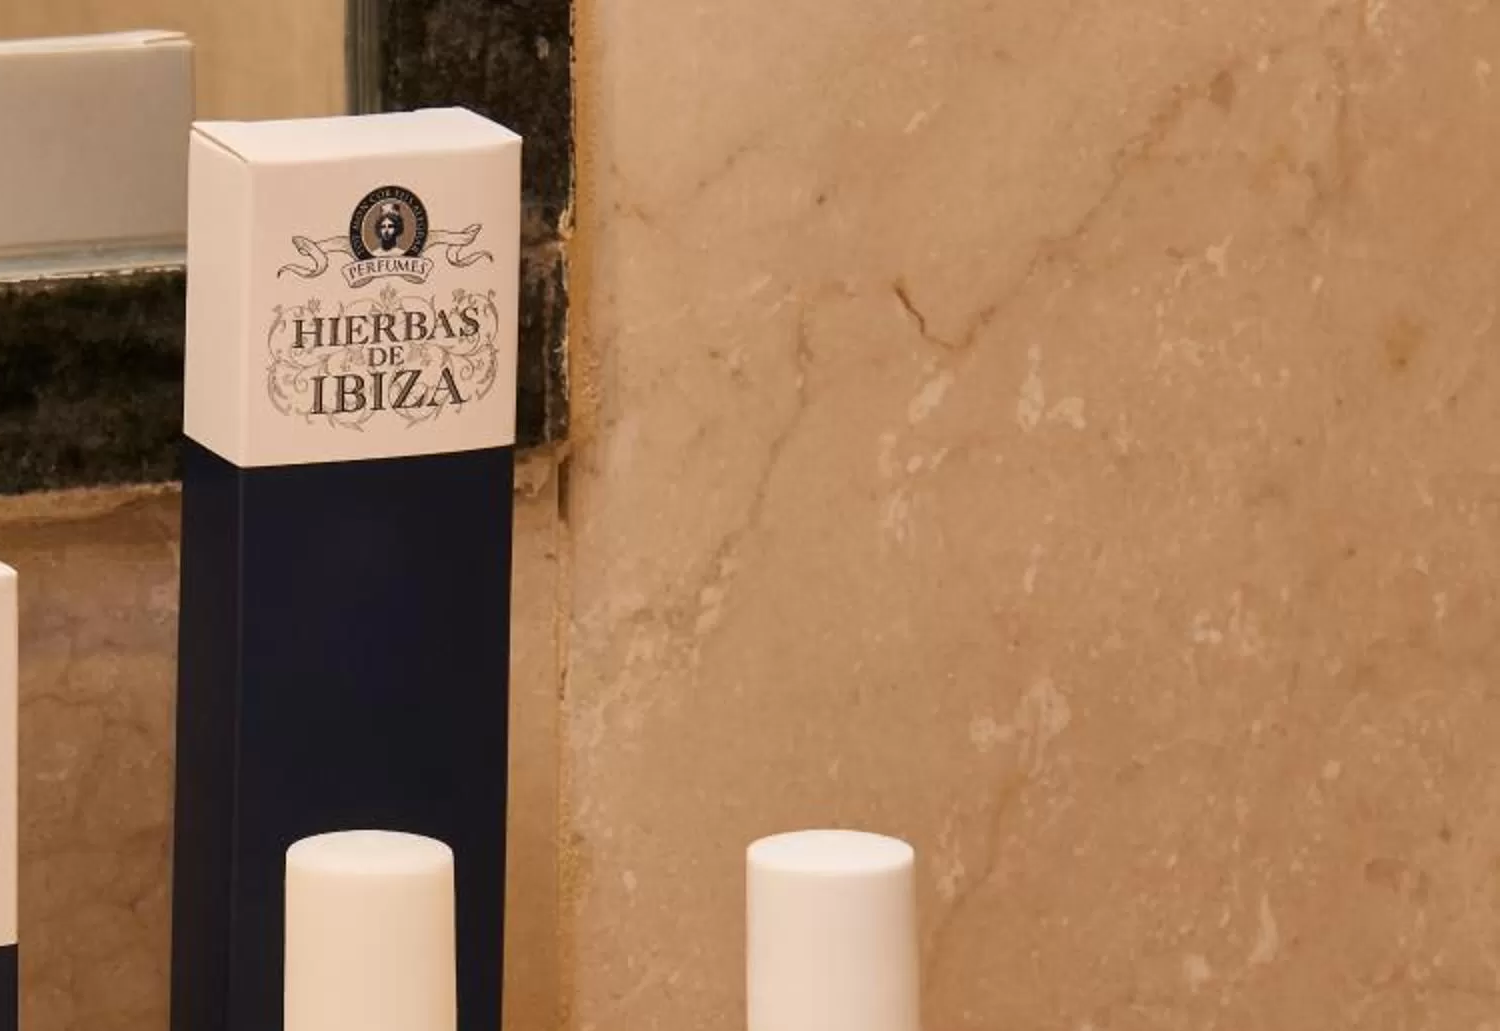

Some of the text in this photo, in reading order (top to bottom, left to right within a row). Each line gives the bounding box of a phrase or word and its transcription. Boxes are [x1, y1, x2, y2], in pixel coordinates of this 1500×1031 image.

[349, 259, 427, 279] PERFUMES
[292, 307, 480, 349] HIERBAS
[367, 345, 404, 367] DE
[310, 366, 468, 415] IBIZA
